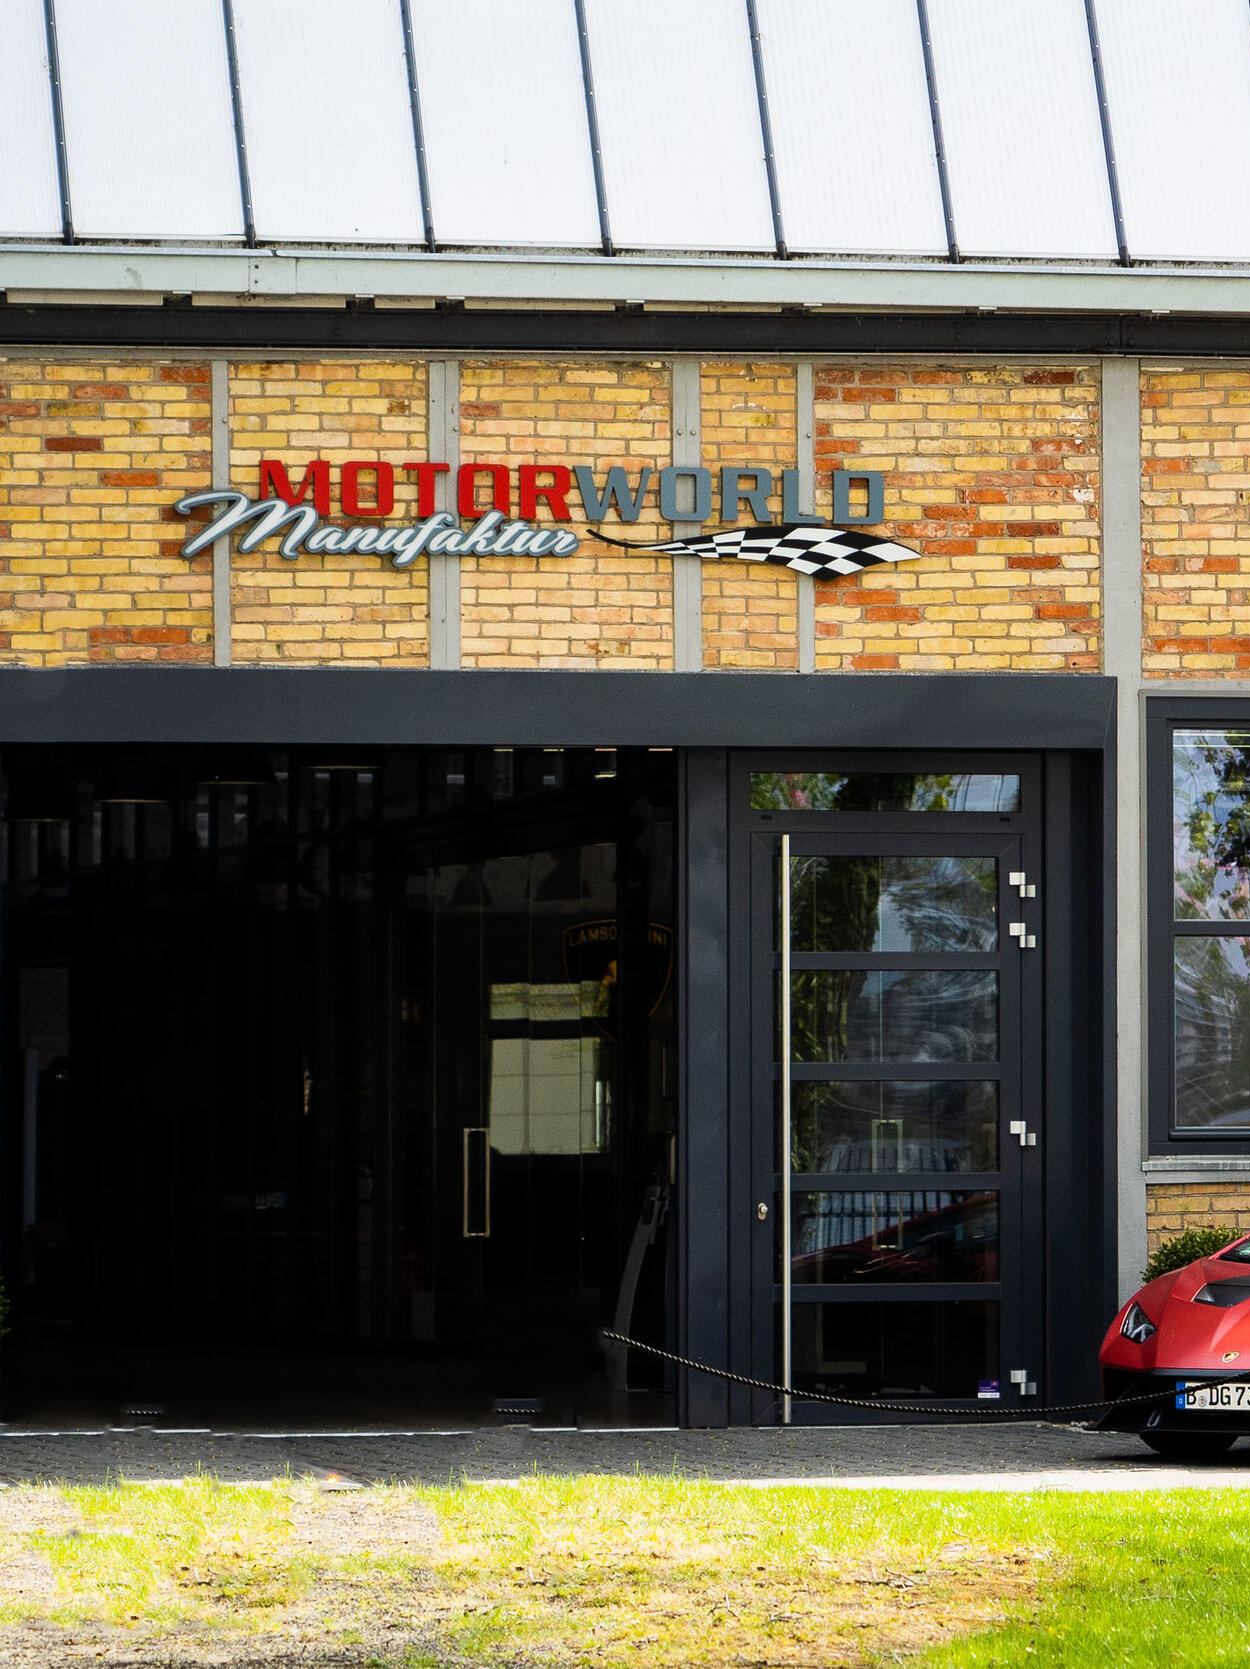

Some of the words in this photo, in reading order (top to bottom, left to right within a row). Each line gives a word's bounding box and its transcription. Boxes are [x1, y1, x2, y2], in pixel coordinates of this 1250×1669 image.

[259, 459, 884, 524] MOTORWORLD
[174, 489, 580, 565] Manufaktur
[569, 926, 667, 947] LAMBOINI
[1186, 1387, 1196, 1405] B
[1209, 1387, 1231, 1406] DG
